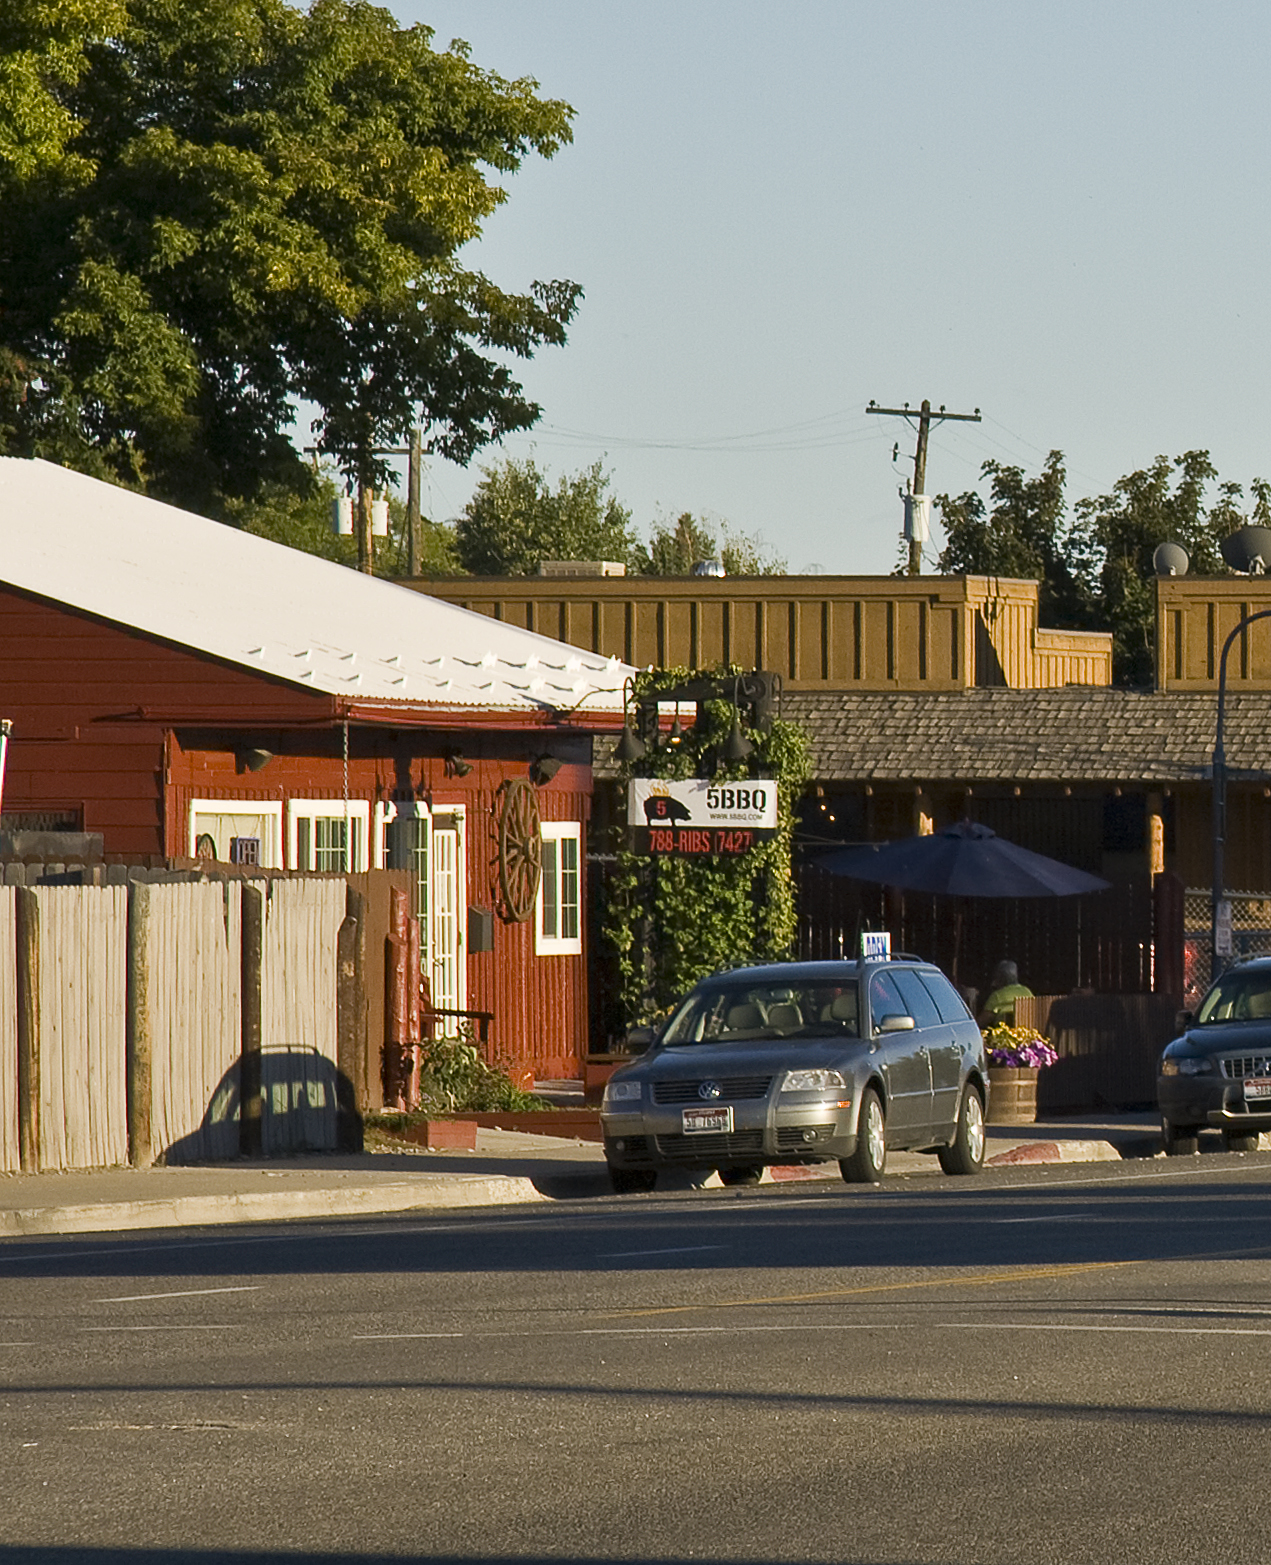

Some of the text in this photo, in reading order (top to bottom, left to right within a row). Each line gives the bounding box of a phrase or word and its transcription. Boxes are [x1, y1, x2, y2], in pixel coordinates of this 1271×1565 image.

[656, 801, 666, 815] 5
[706, 788, 767, 813] 5BBQ
[649, 830, 711, 852] 788-RIBS
